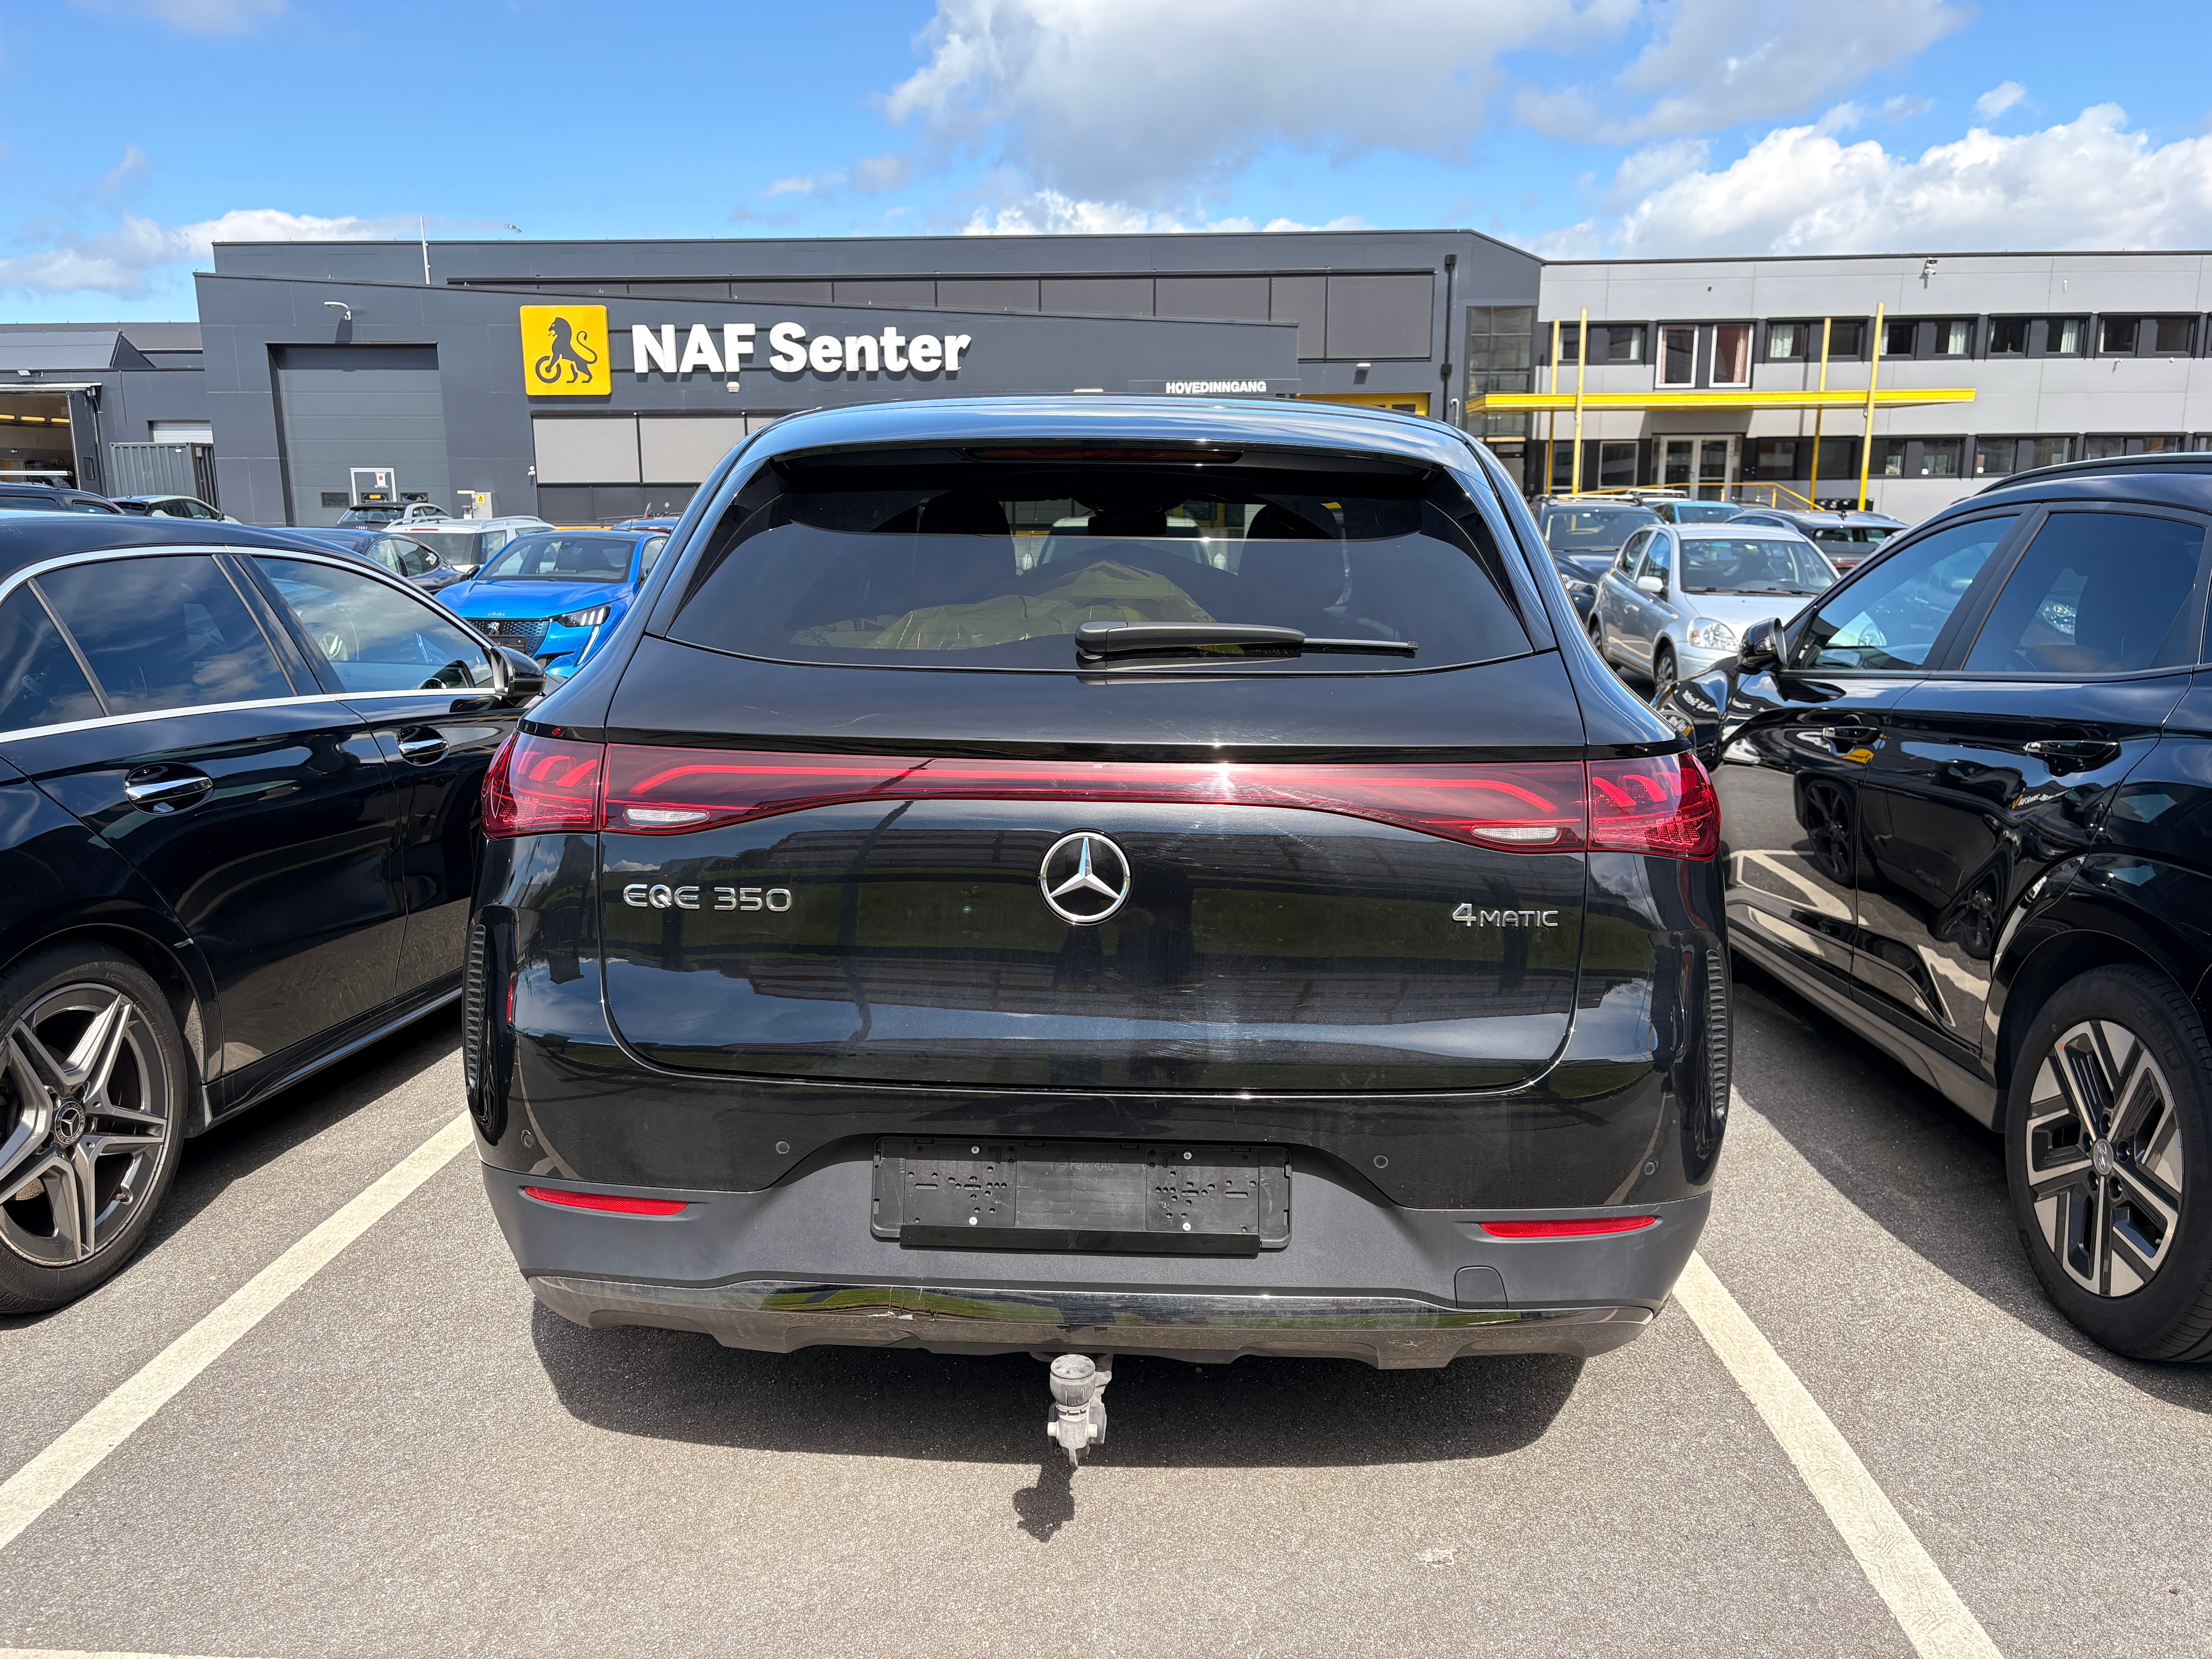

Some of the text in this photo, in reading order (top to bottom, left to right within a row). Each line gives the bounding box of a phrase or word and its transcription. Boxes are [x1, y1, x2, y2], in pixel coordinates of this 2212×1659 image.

[632, 322, 972, 373] NAF Senter
[1166, 381, 1267, 394] HOVEDINNGANG
[623, 884, 792, 912] EQE 350
[1452, 903, 1558, 927] 4MATIC
